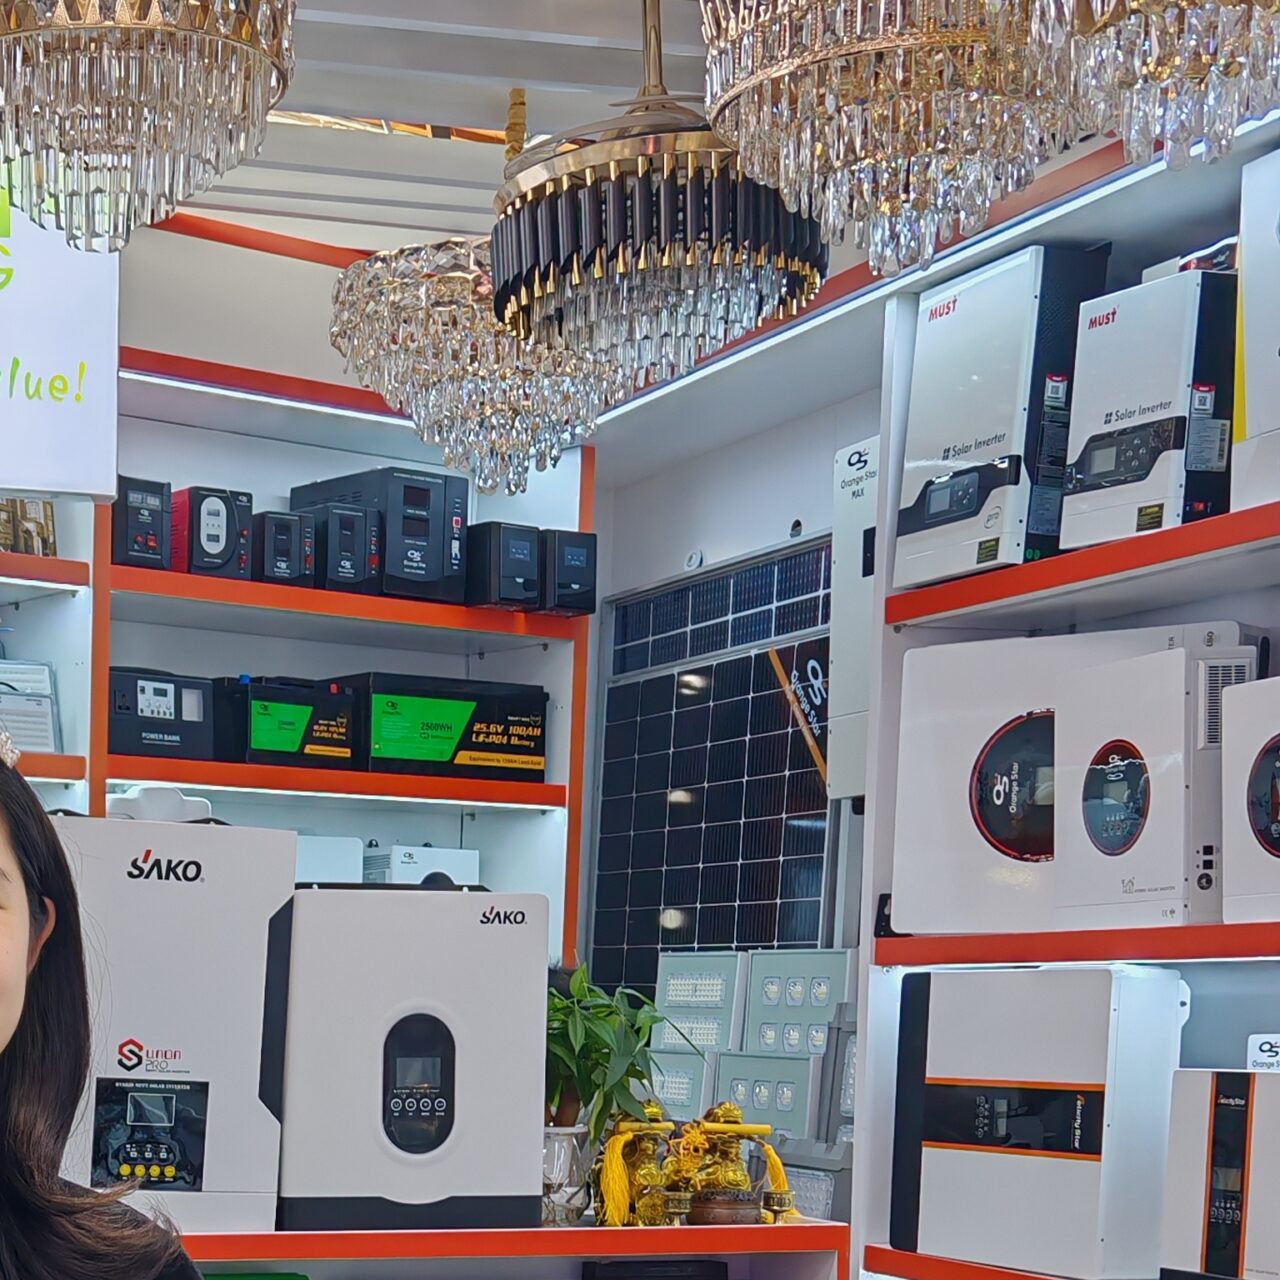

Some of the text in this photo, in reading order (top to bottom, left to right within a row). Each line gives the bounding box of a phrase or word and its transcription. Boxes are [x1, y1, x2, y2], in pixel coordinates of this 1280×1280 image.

[927, 295, 958, 323] MUST
[1087, 307, 1118, 331] MUST
[1114, 399, 1173, 423] Solar Inverter
[951, 431, 1007, 459] Solar Inverter
[840, 473, 864, 490] Orange
[851, 487, 865, 500] MAX
[141, 731, 181, 742] POWER BANK
[126, 849, 202, 883] SAKO
[479, 906, 527, 925] SAKO
[1251, 1060, 1275, 1069] Orange
